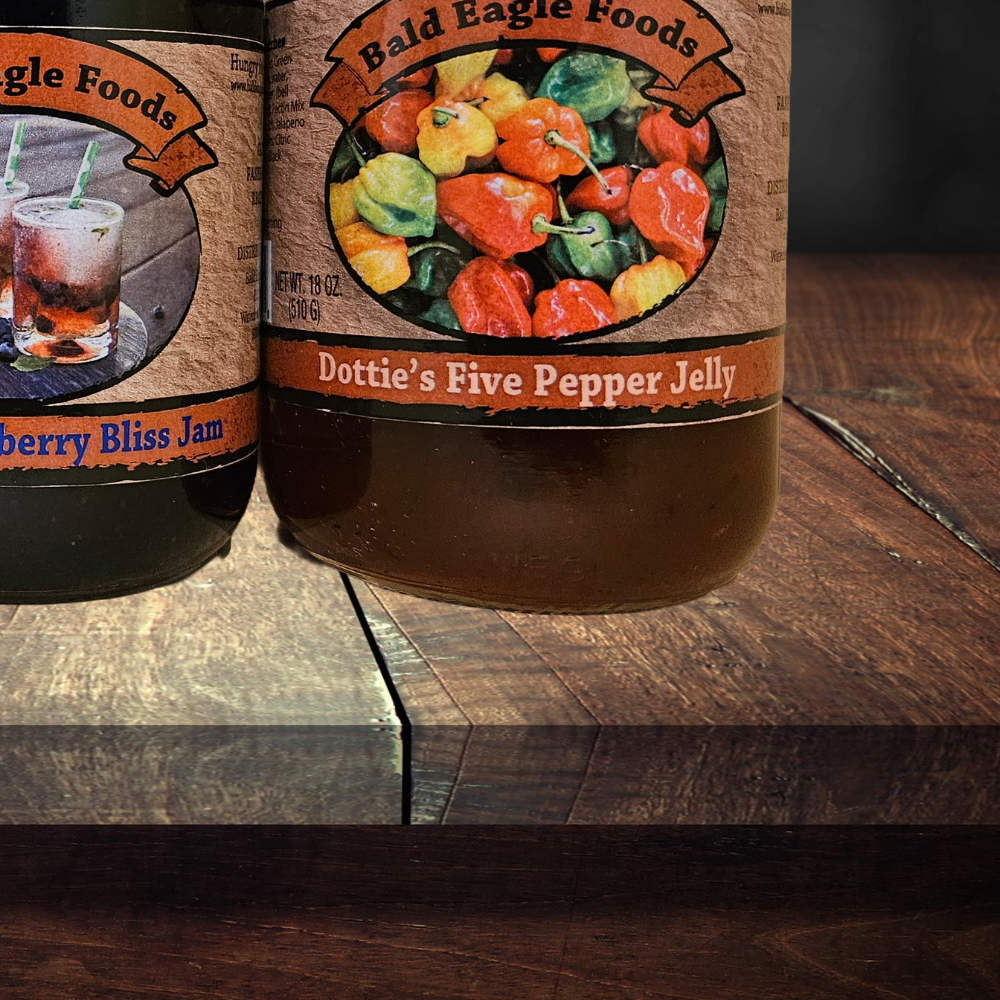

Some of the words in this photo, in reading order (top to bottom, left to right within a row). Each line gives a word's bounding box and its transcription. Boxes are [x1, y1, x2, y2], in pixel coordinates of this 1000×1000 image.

[357, 9, 447, 74] Bald
[230, 53, 259, 78] Hungry
[74, 63, 178, 132] Foods
[275, 270, 288, 292] NET
[290, 272, 305, 295] WT.
[309, 274, 321, 296] 18
[325, 275, 343, 298] OZ.
[288, 298, 307, 323] (510
[310, 299, 321, 326] G)
[318, 350, 436, 394] Dottie's
[447, 361, 522, 396] Five
[534, 361, 661, 408] Pepper
[670, 358, 737, 399] Jelly
[100, 418, 170, 455] Bliss
[177, 414, 224, 449] Jam
